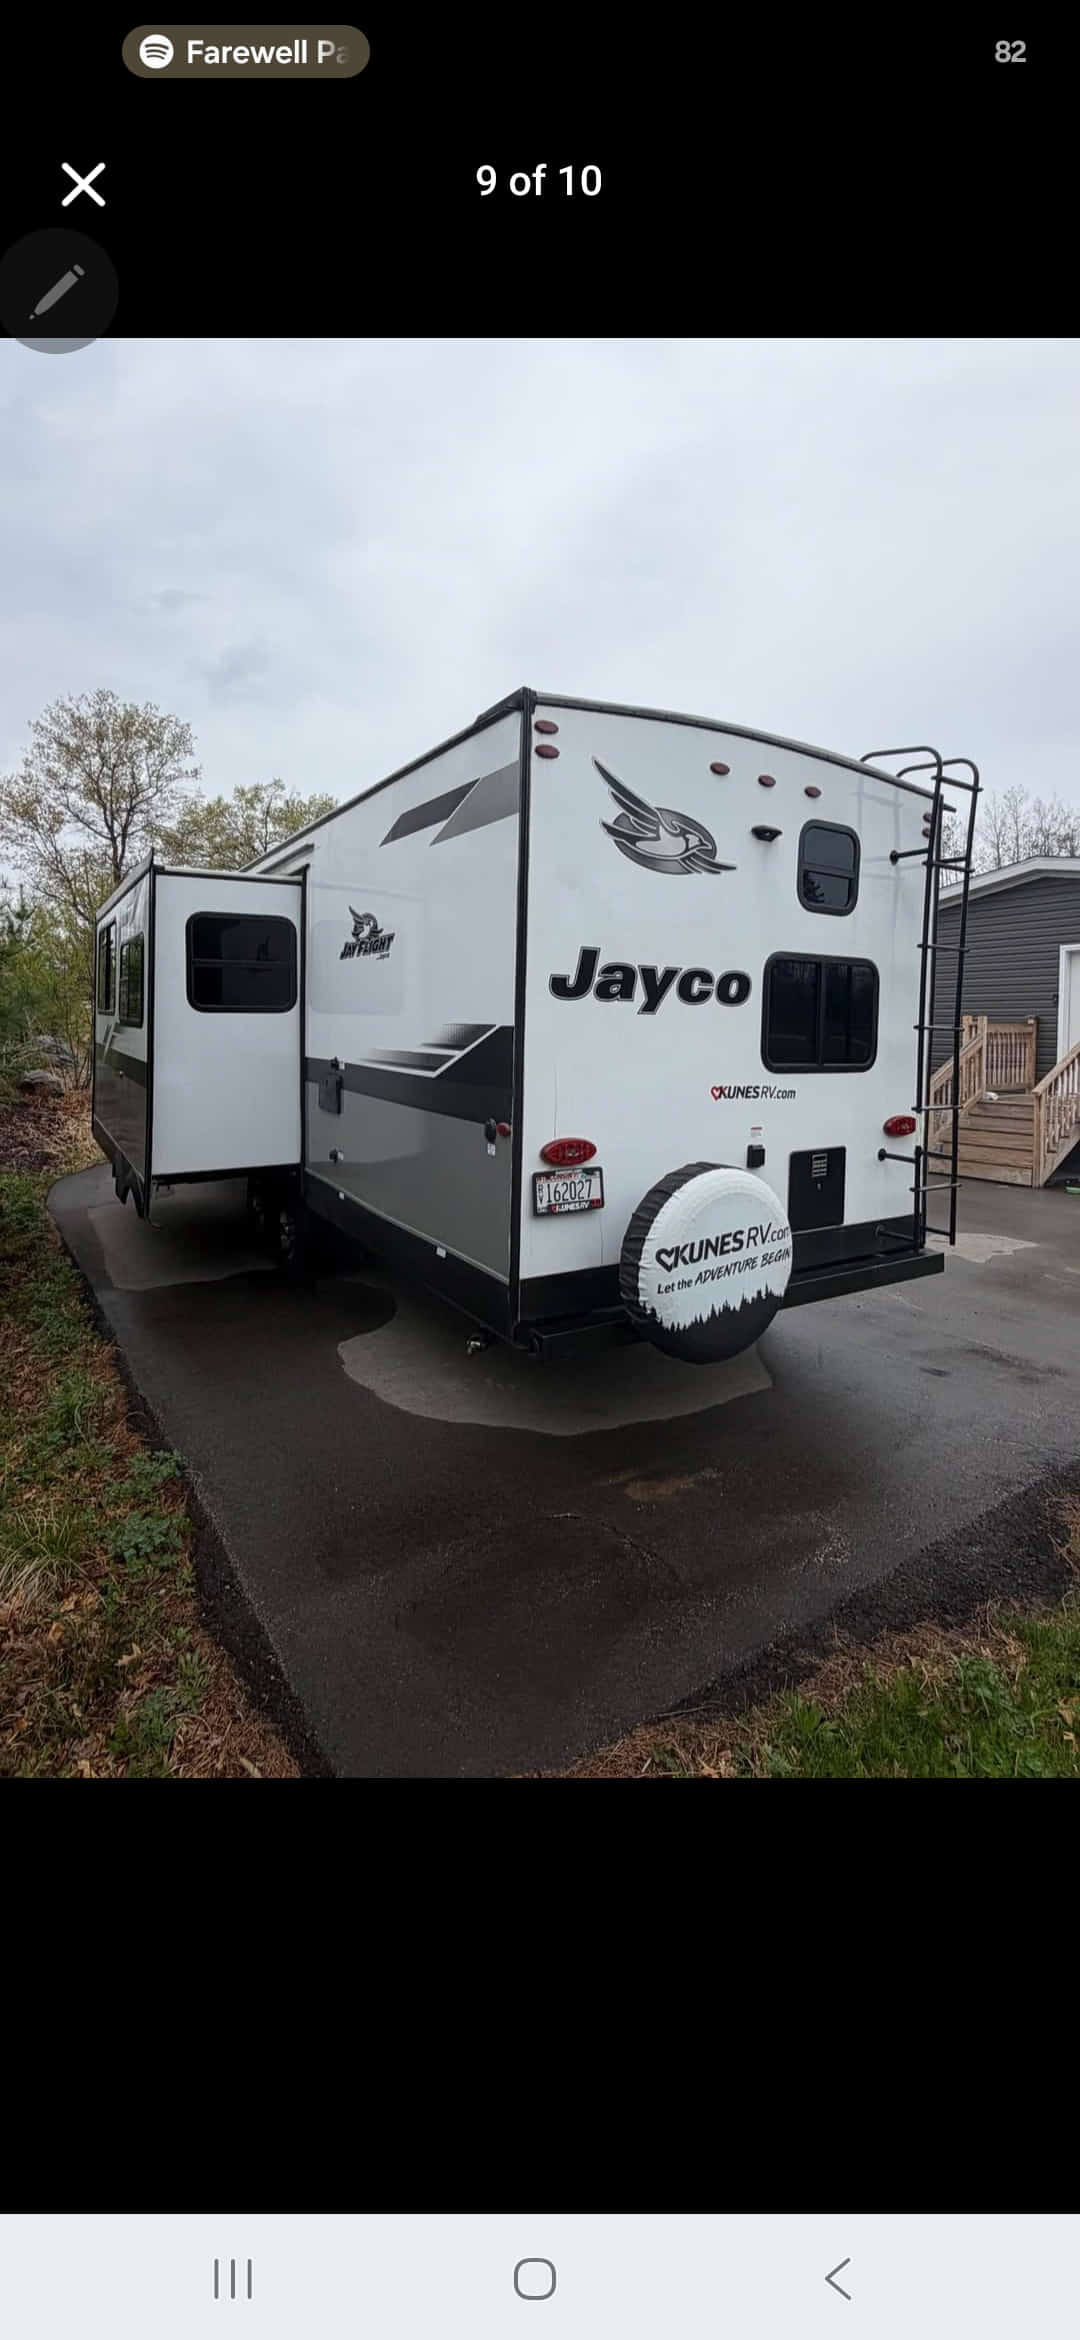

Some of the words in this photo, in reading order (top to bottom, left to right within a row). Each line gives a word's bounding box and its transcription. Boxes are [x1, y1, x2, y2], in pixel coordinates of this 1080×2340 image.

[549, 946, 752, 1015] Jayco
[547, 1179, 592, 1203] 162027
[657, 1283, 675, 1295] Let
[677, 1277, 693, 1290] the
[694, 1255, 759, 1287] ADVENTURE
